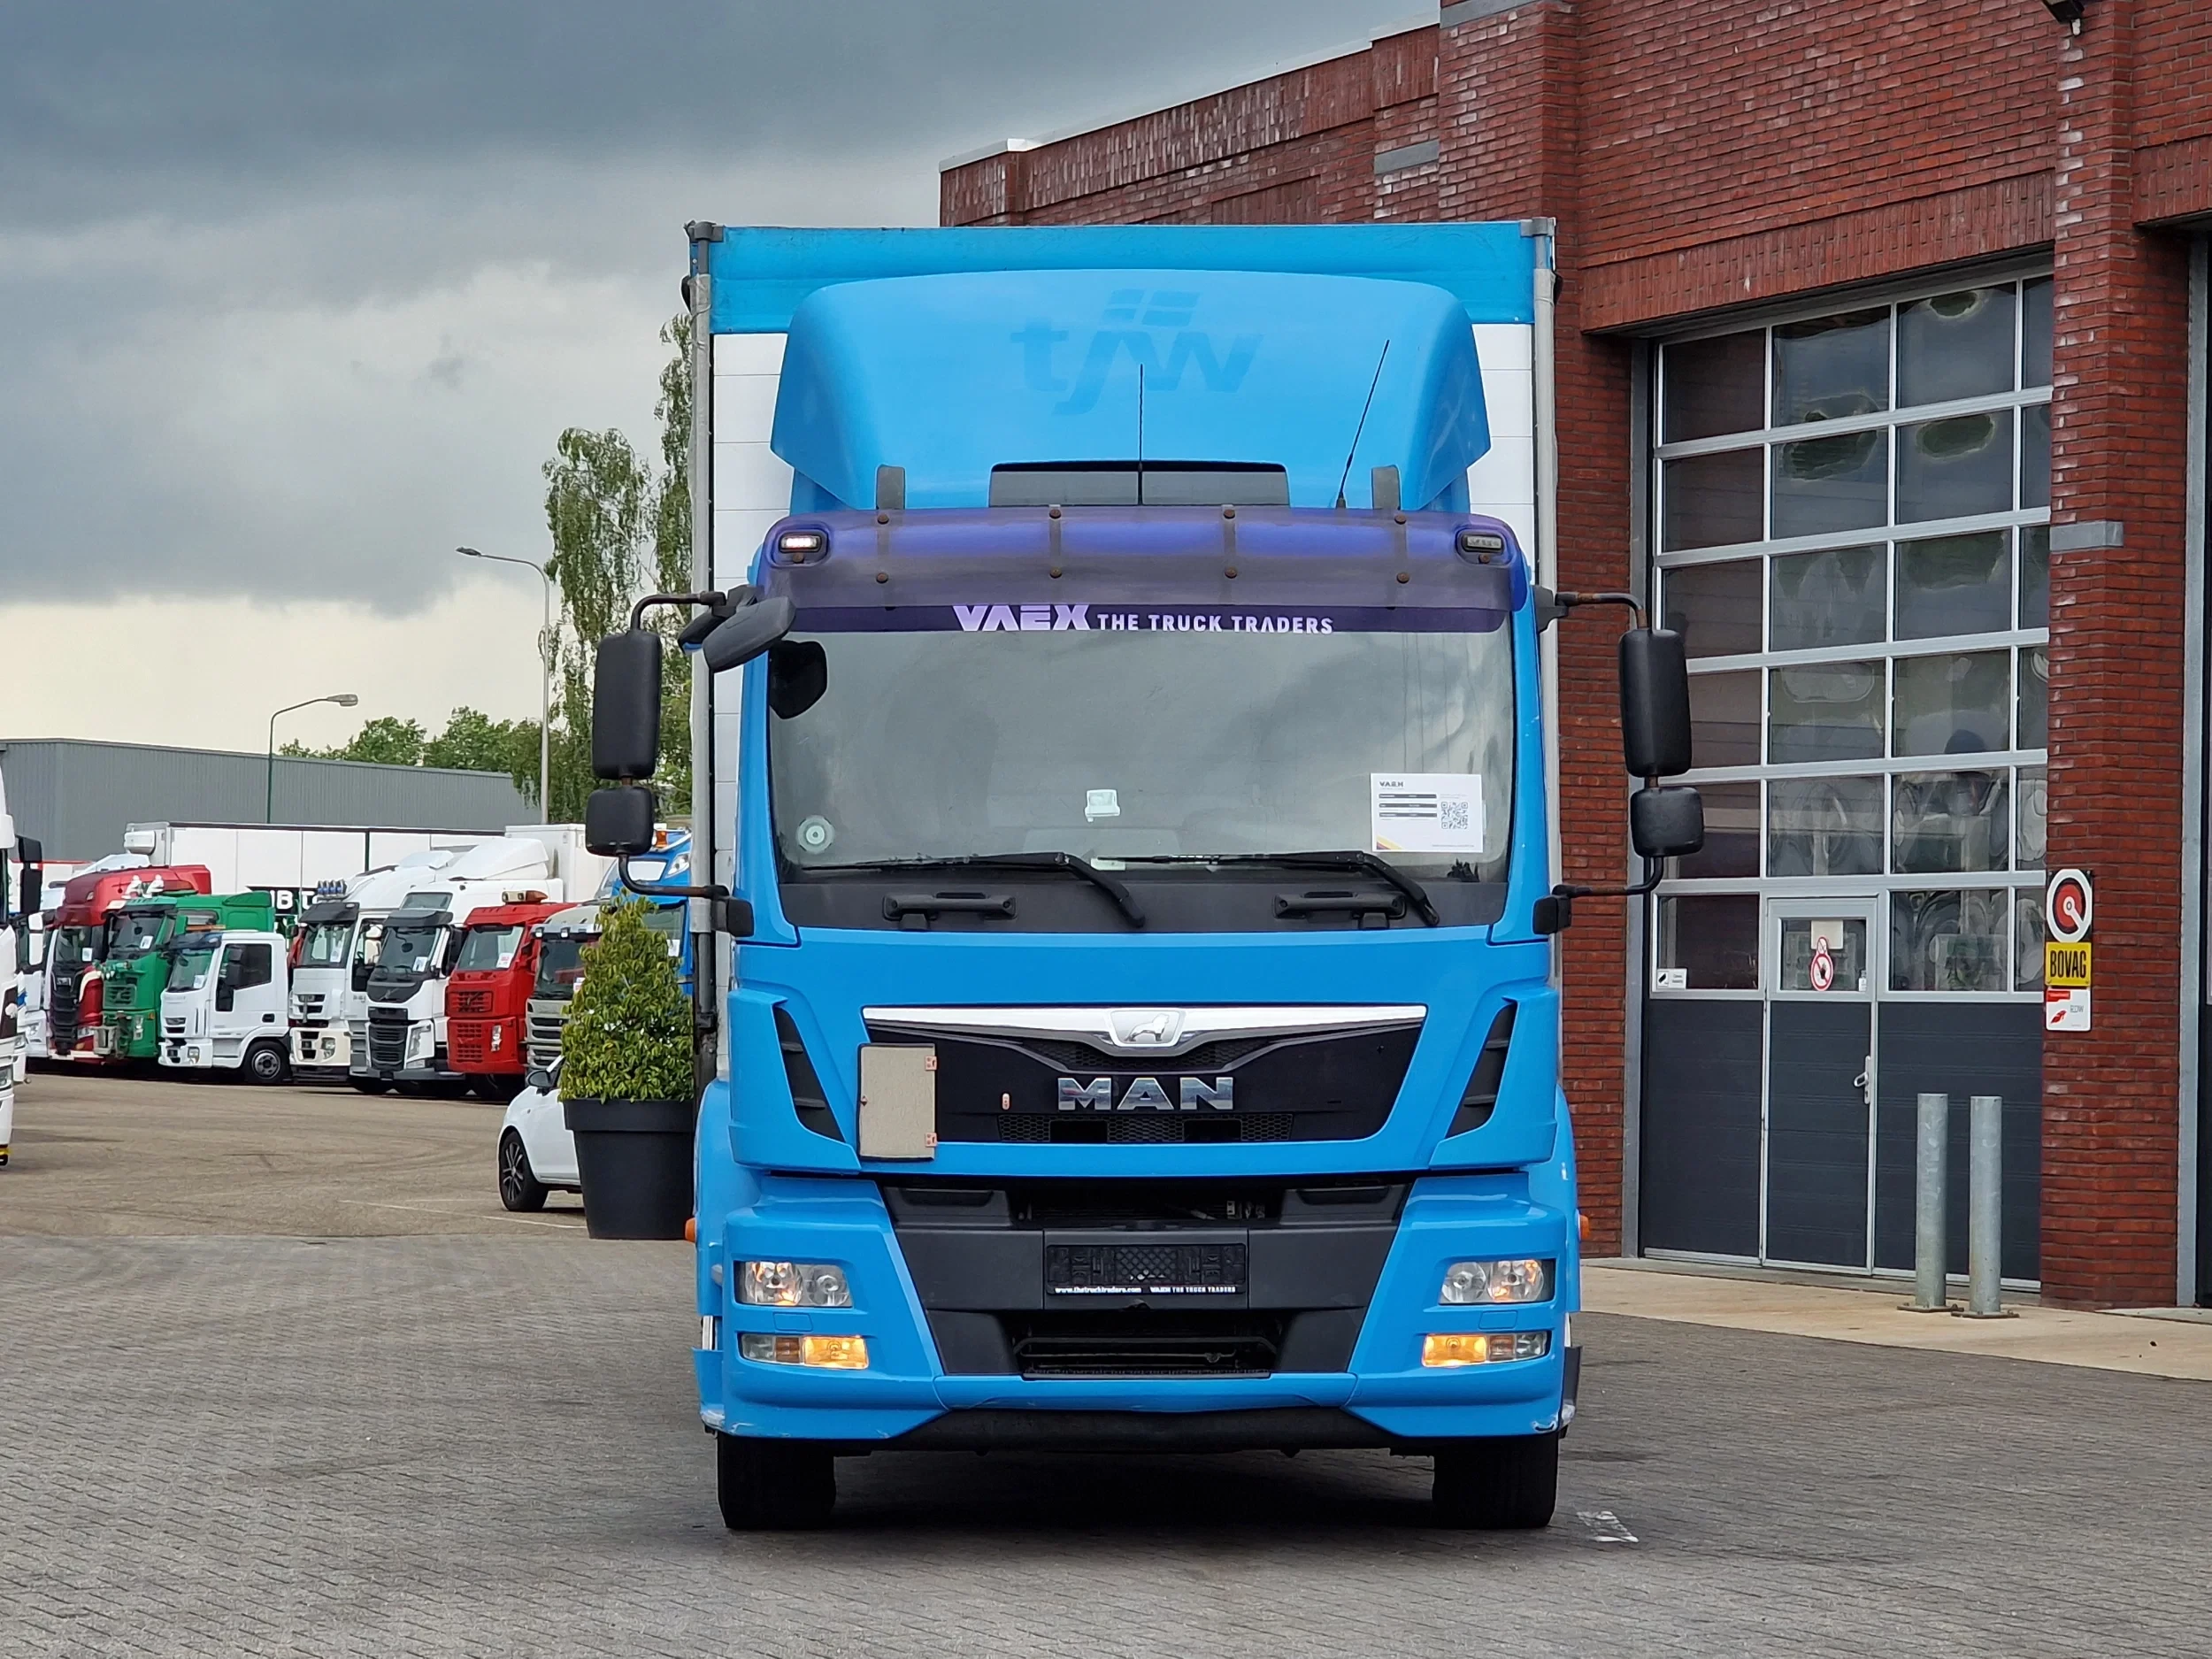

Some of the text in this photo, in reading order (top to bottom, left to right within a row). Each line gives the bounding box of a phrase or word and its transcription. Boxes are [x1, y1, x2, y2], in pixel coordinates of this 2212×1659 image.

[952, 604, 1333, 634] VAEX THE TRUCK TRADERS
[2049, 949, 2087, 979] BOVAG
[1057, 1077, 1233, 1110] MAN
